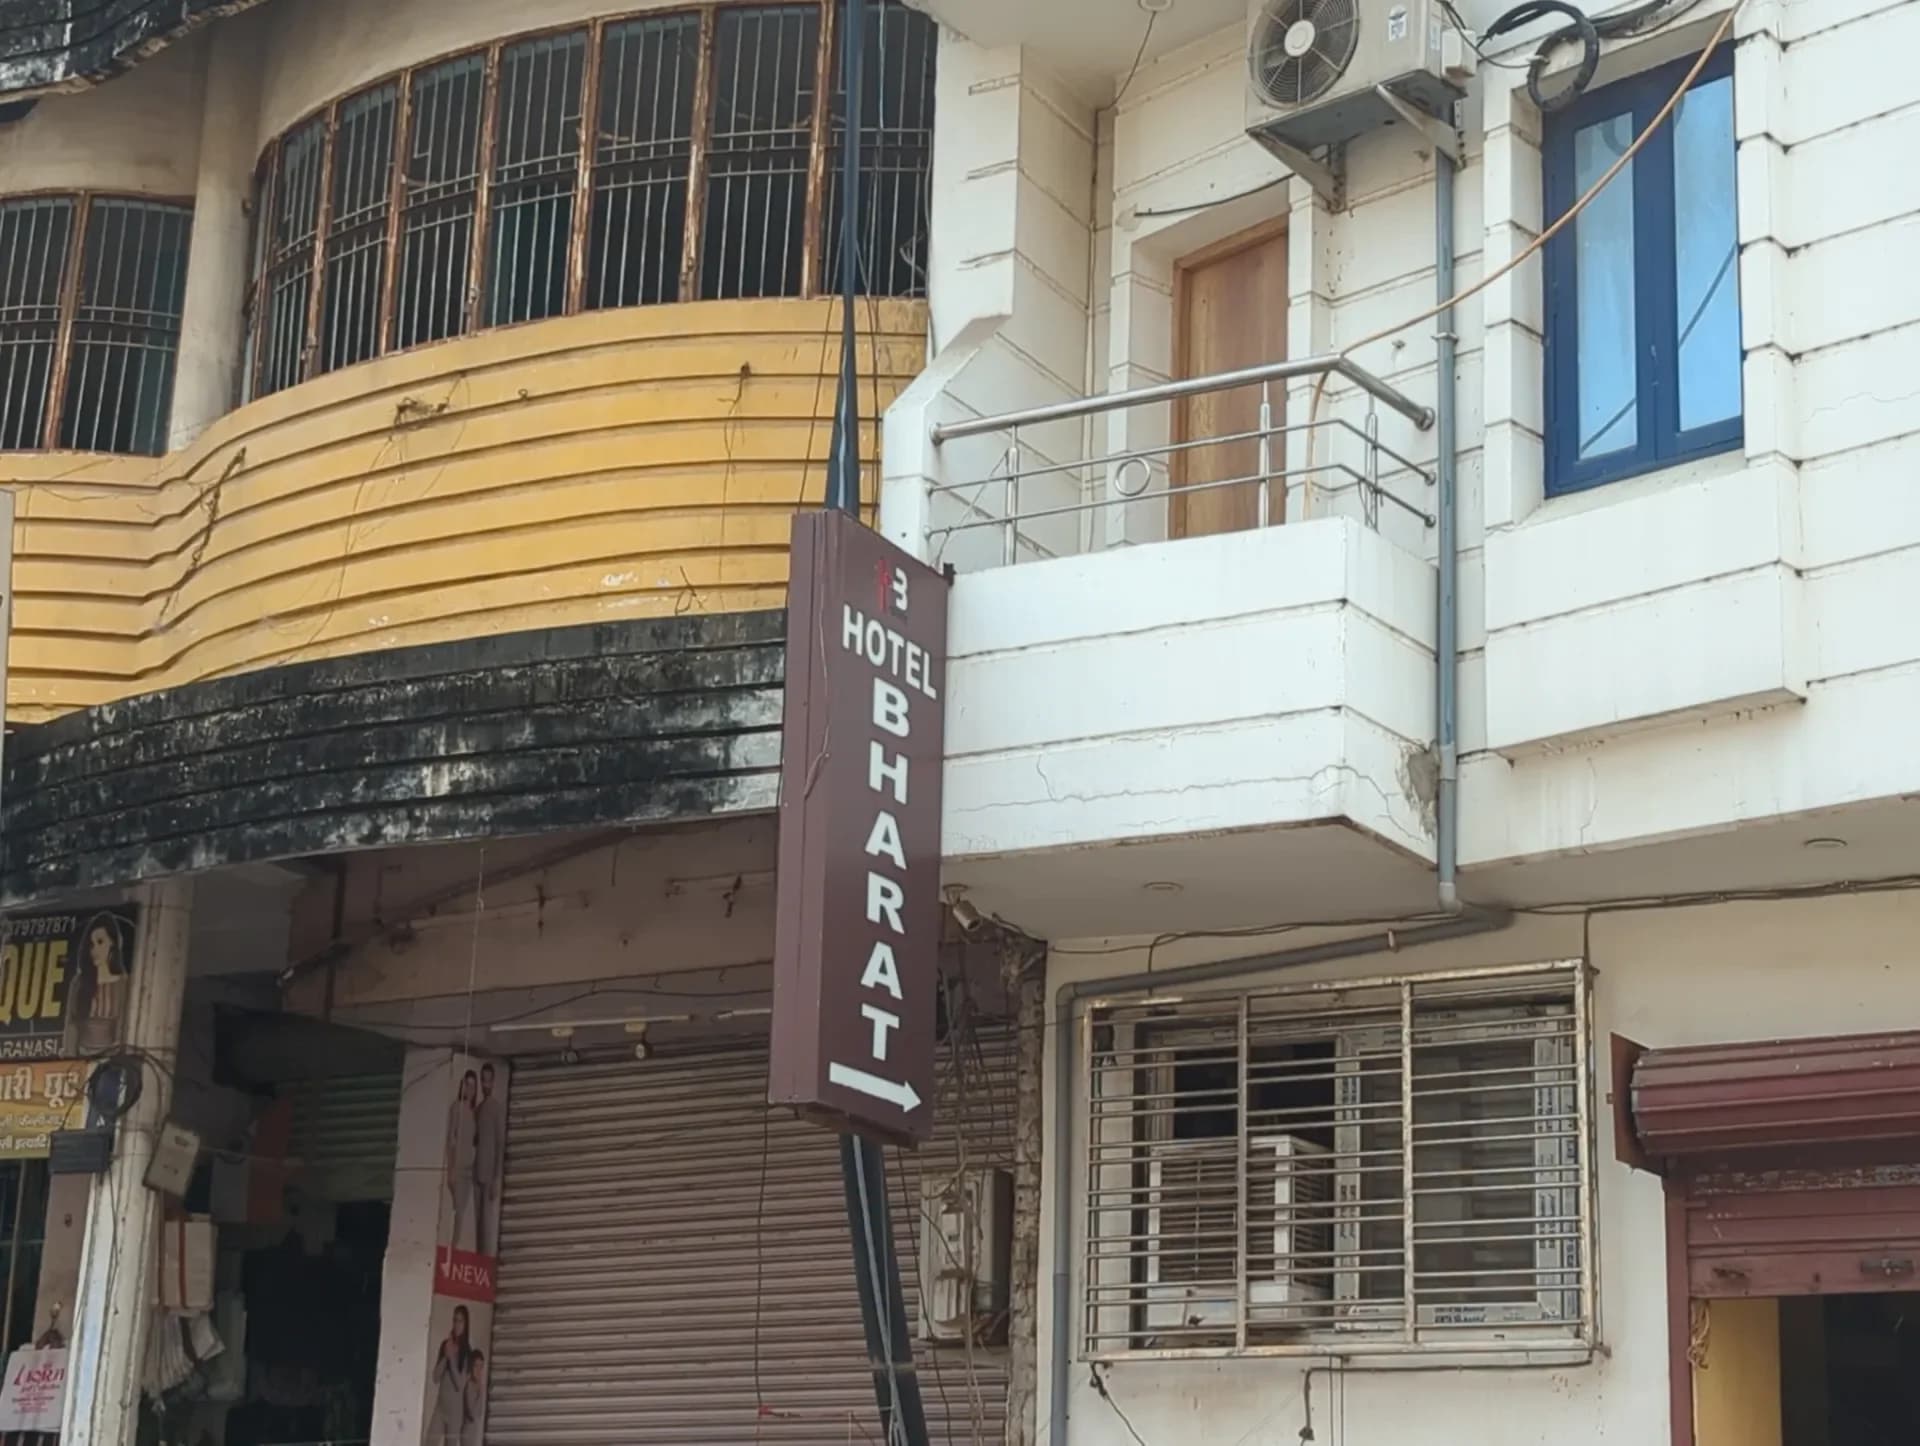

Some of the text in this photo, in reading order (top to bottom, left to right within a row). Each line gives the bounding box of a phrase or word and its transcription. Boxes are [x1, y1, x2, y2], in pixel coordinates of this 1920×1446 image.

[842, 603, 937, 700] HOTEL
[860, 676, 910, 1062] BHARAT
[450, 1263, 491, 1289] NEVA
